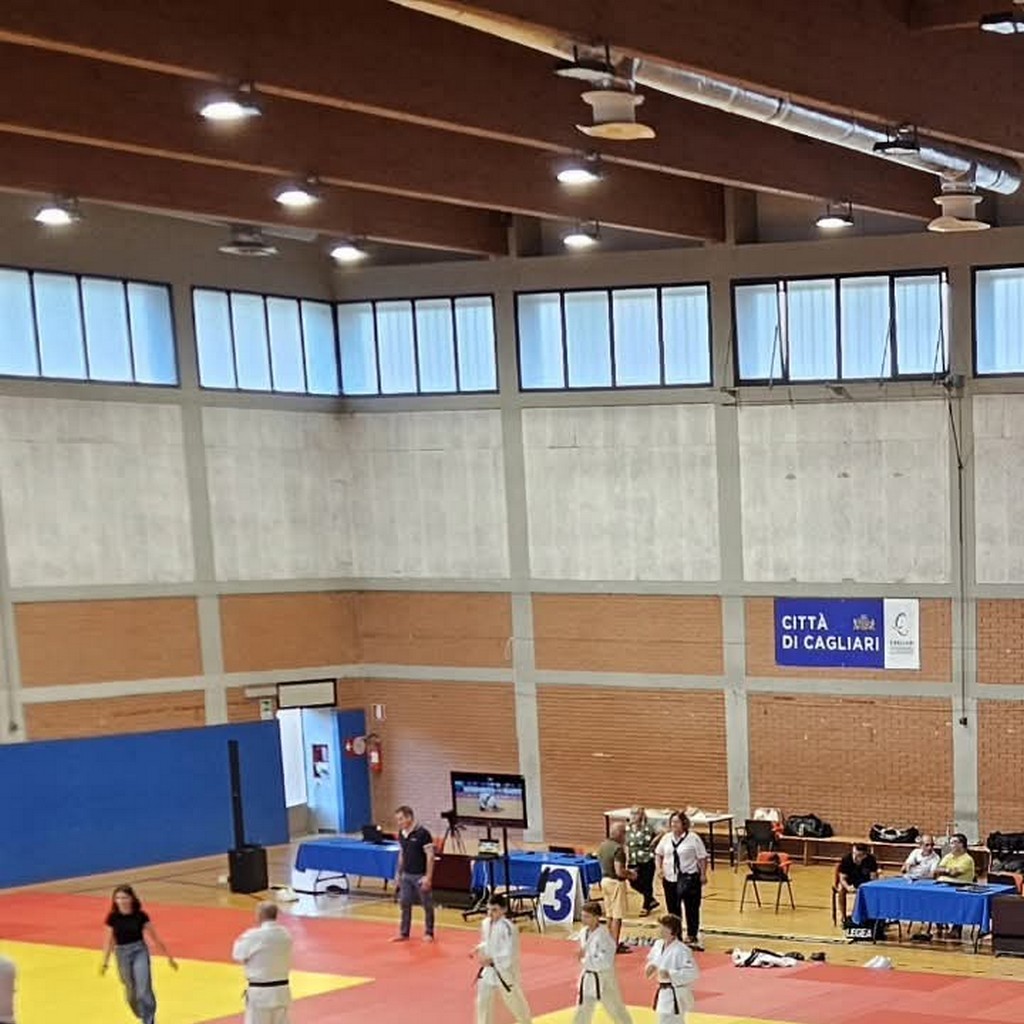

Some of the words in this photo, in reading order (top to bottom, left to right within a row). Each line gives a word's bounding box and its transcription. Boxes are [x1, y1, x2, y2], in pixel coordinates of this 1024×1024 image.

[781, 612, 829, 631] CITTÀ
[782, 635, 798, 649] DI
[803, 635, 880, 652] CAGLIARI
[543, 868, 573, 921] 3
